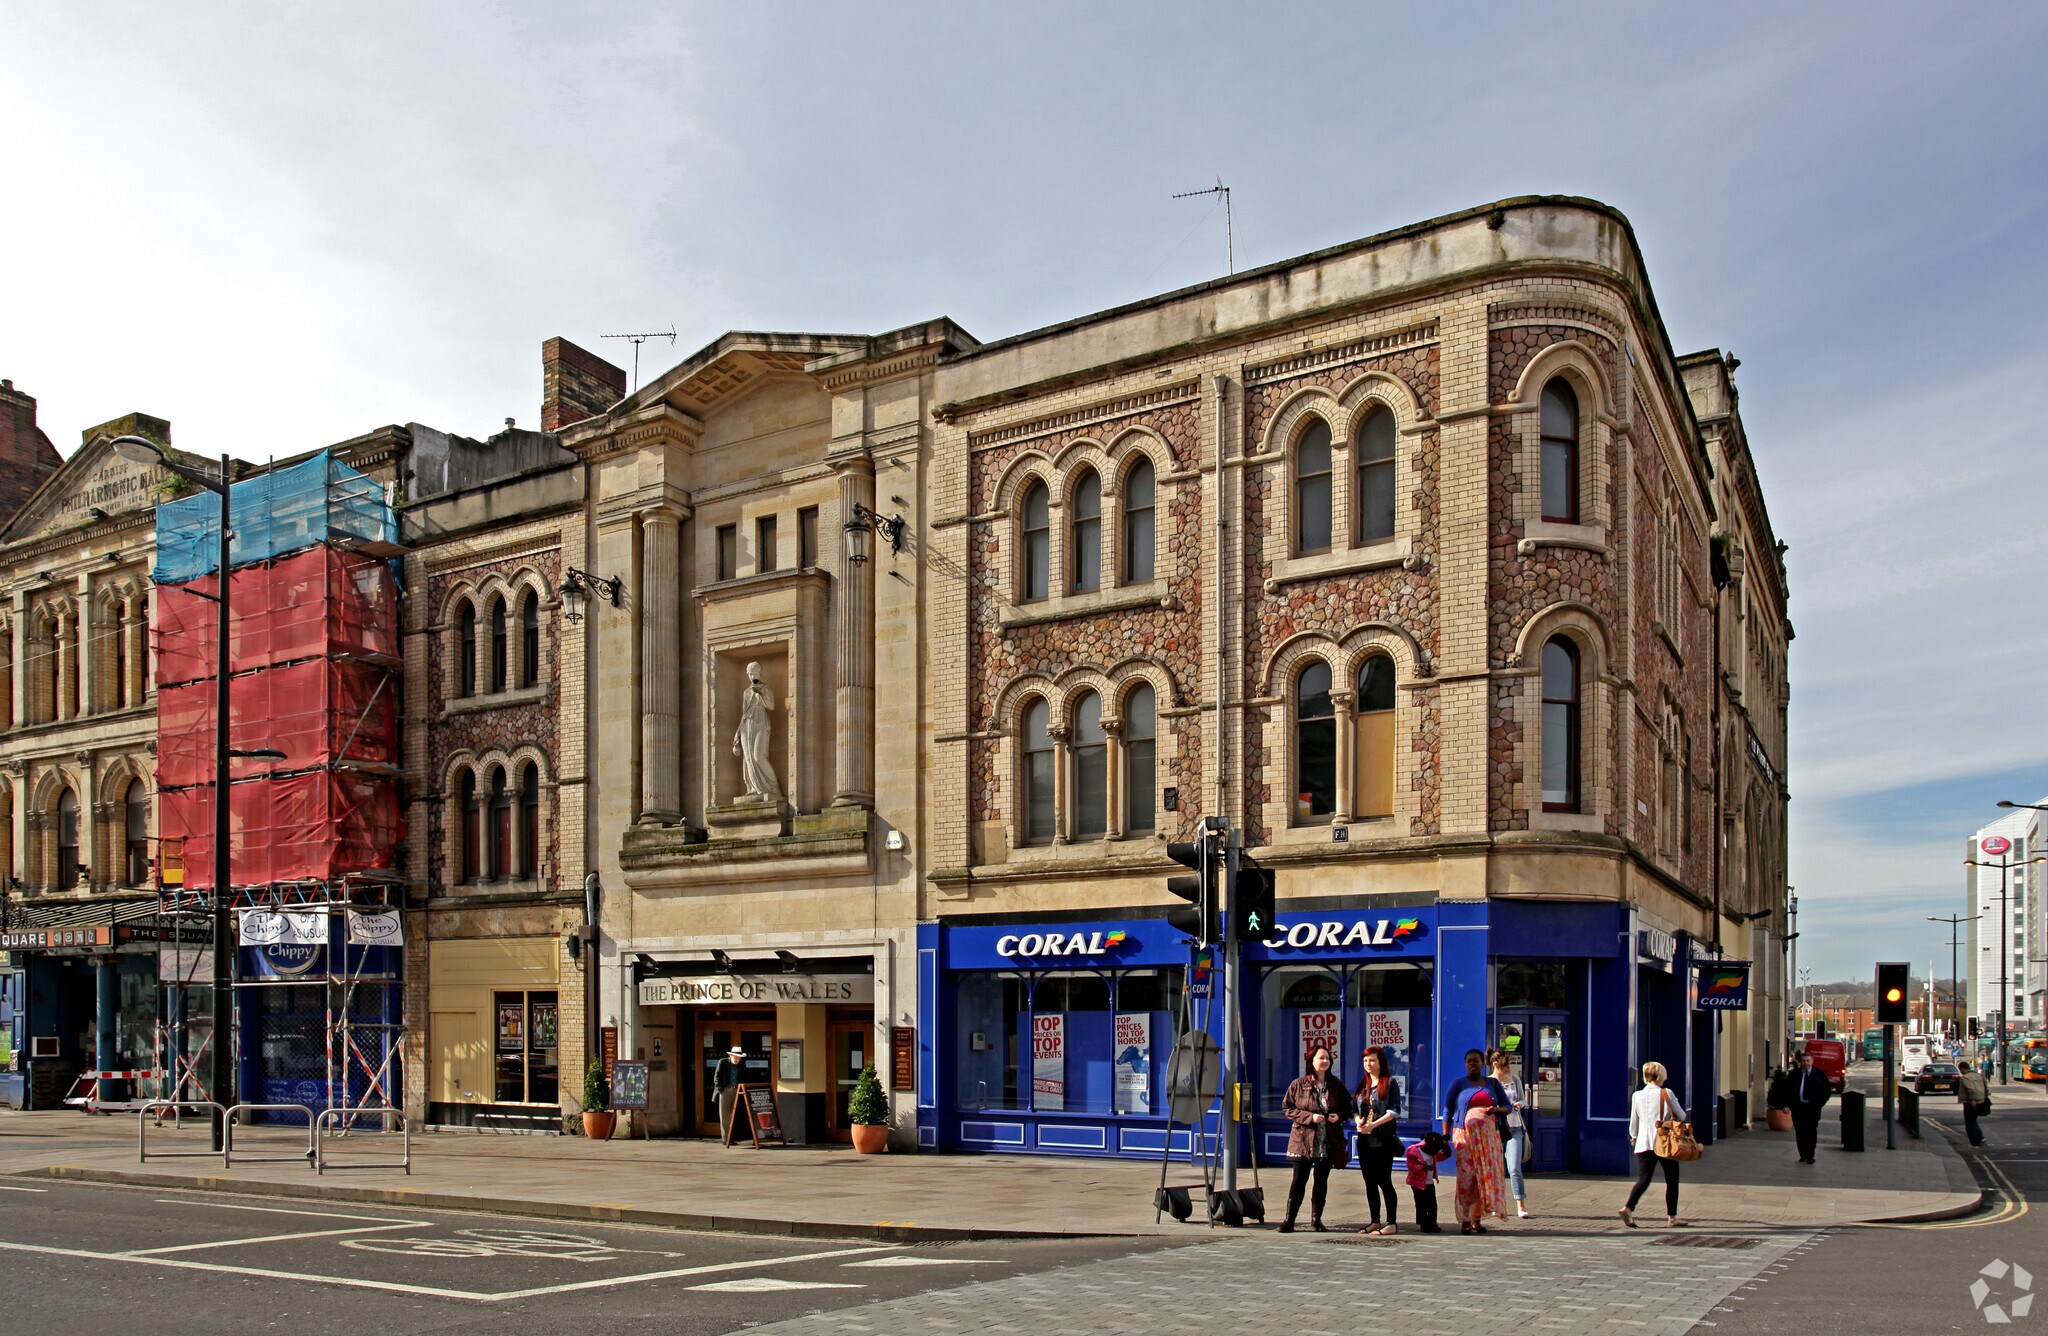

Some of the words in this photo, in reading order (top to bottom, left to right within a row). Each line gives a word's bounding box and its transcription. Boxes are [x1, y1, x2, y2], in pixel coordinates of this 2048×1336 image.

[93, 463, 128, 482] CARDIFF
[61, 476, 137, 514] PHILHARMONIC
[353, 923, 394, 933] Chippy
[132, 929, 158, 938] THE
[169, 931, 214, 940] SQUAR
[1262, 919, 1393, 948] CORAL
[996, 932, 1106, 956] CORAL
[268, 944, 312, 960] Chippy
[643, 985, 667, 1001] THE
[670, 982, 733, 1001] PRINCE
[739, 982, 766, 999] OF
[775, 982, 852, 999] WALES
[1192, 984, 1210, 994] CORA
[1700, 997, 1744, 1006] CORAL
[1301, 1013, 1336, 1030] TOP
[1369, 1014, 1386, 1022] TOP
[1034, 1017, 1060, 1031] TOP
[1117, 1023, 1142, 1031] PRICES
[1370, 1021, 1399, 1030] PRICES
[1302, 1029, 1327, 1037] PRICES
[1370, 1029, 1383, 1037] ON
[1386, 1028, 1402, 1036] TOP
[1034, 1037, 1061, 1052] TOP
[1118, 1037, 1146, 1045] HORSES
[1303, 1036, 1337, 1053] TOP
[1371, 1036, 1404, 1045] HORSES
[1034, 1051, 1062, 1060] EVENTS
